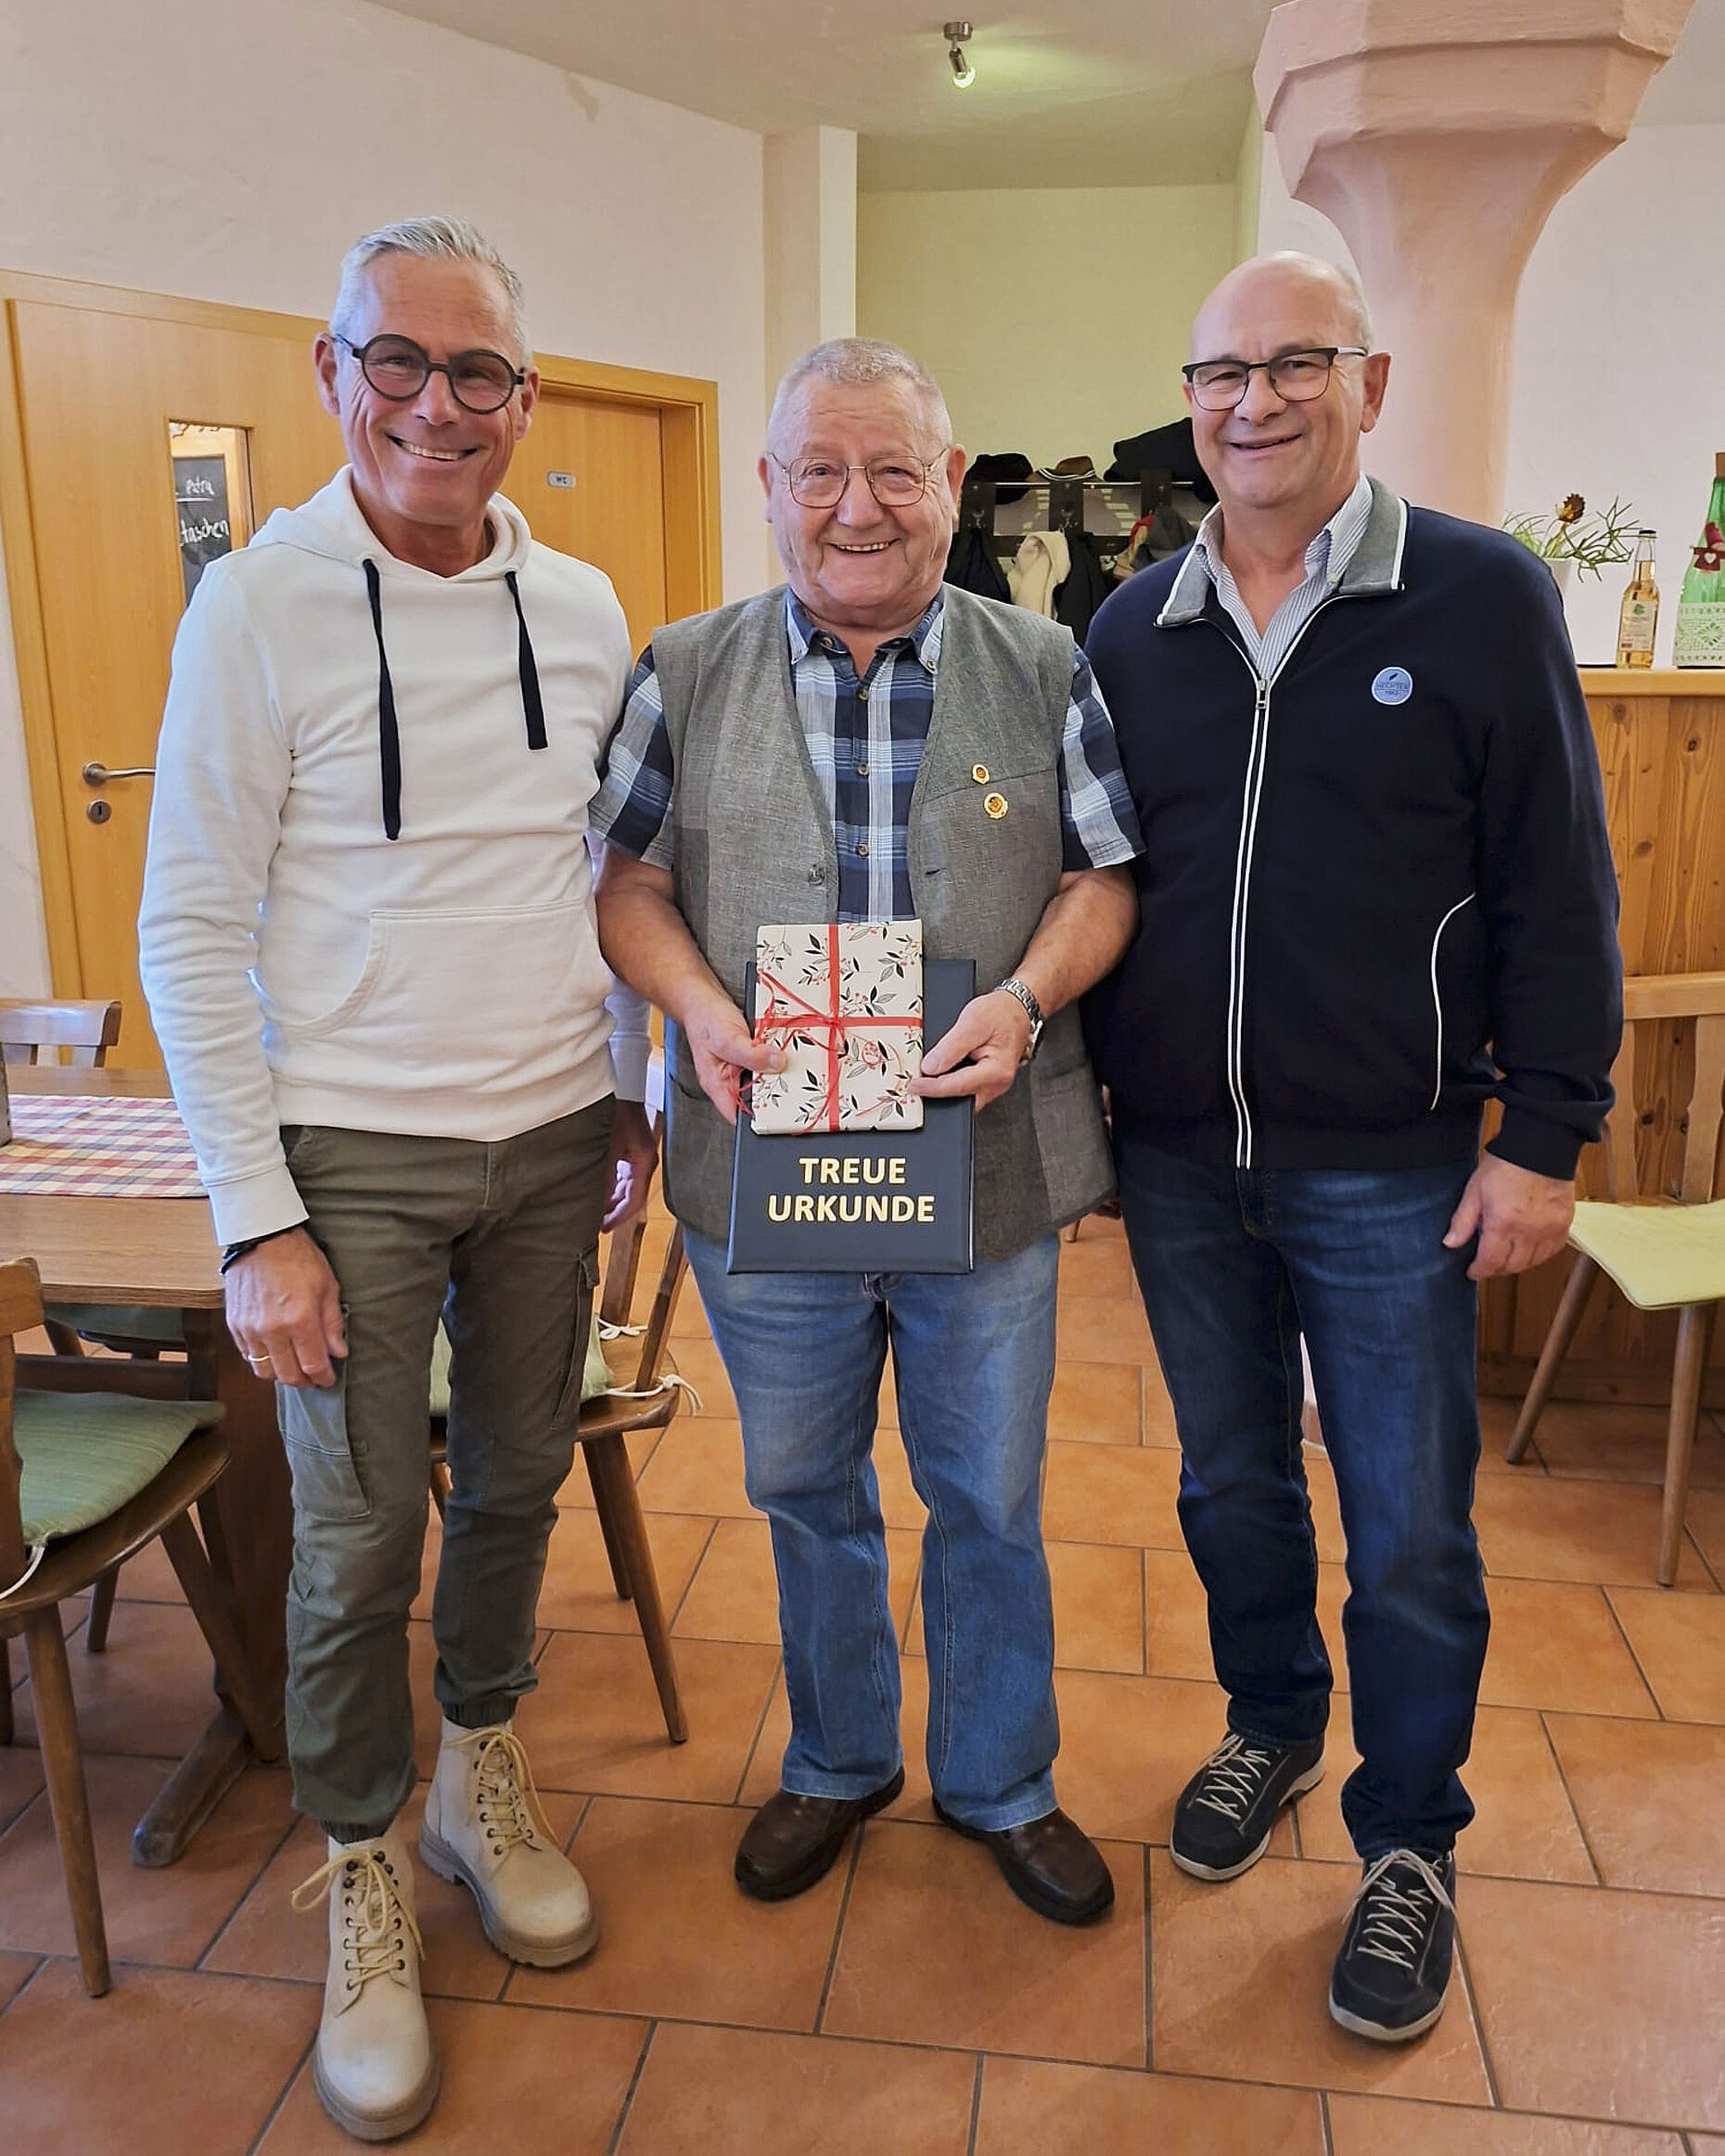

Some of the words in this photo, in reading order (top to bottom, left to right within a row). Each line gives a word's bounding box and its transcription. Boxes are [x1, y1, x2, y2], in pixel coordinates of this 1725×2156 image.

[180, 517, 230, 546] taschen
[799, 1157, 907, 1184] TREUE
[768, 1194, 936, 1222] URKUNDE
